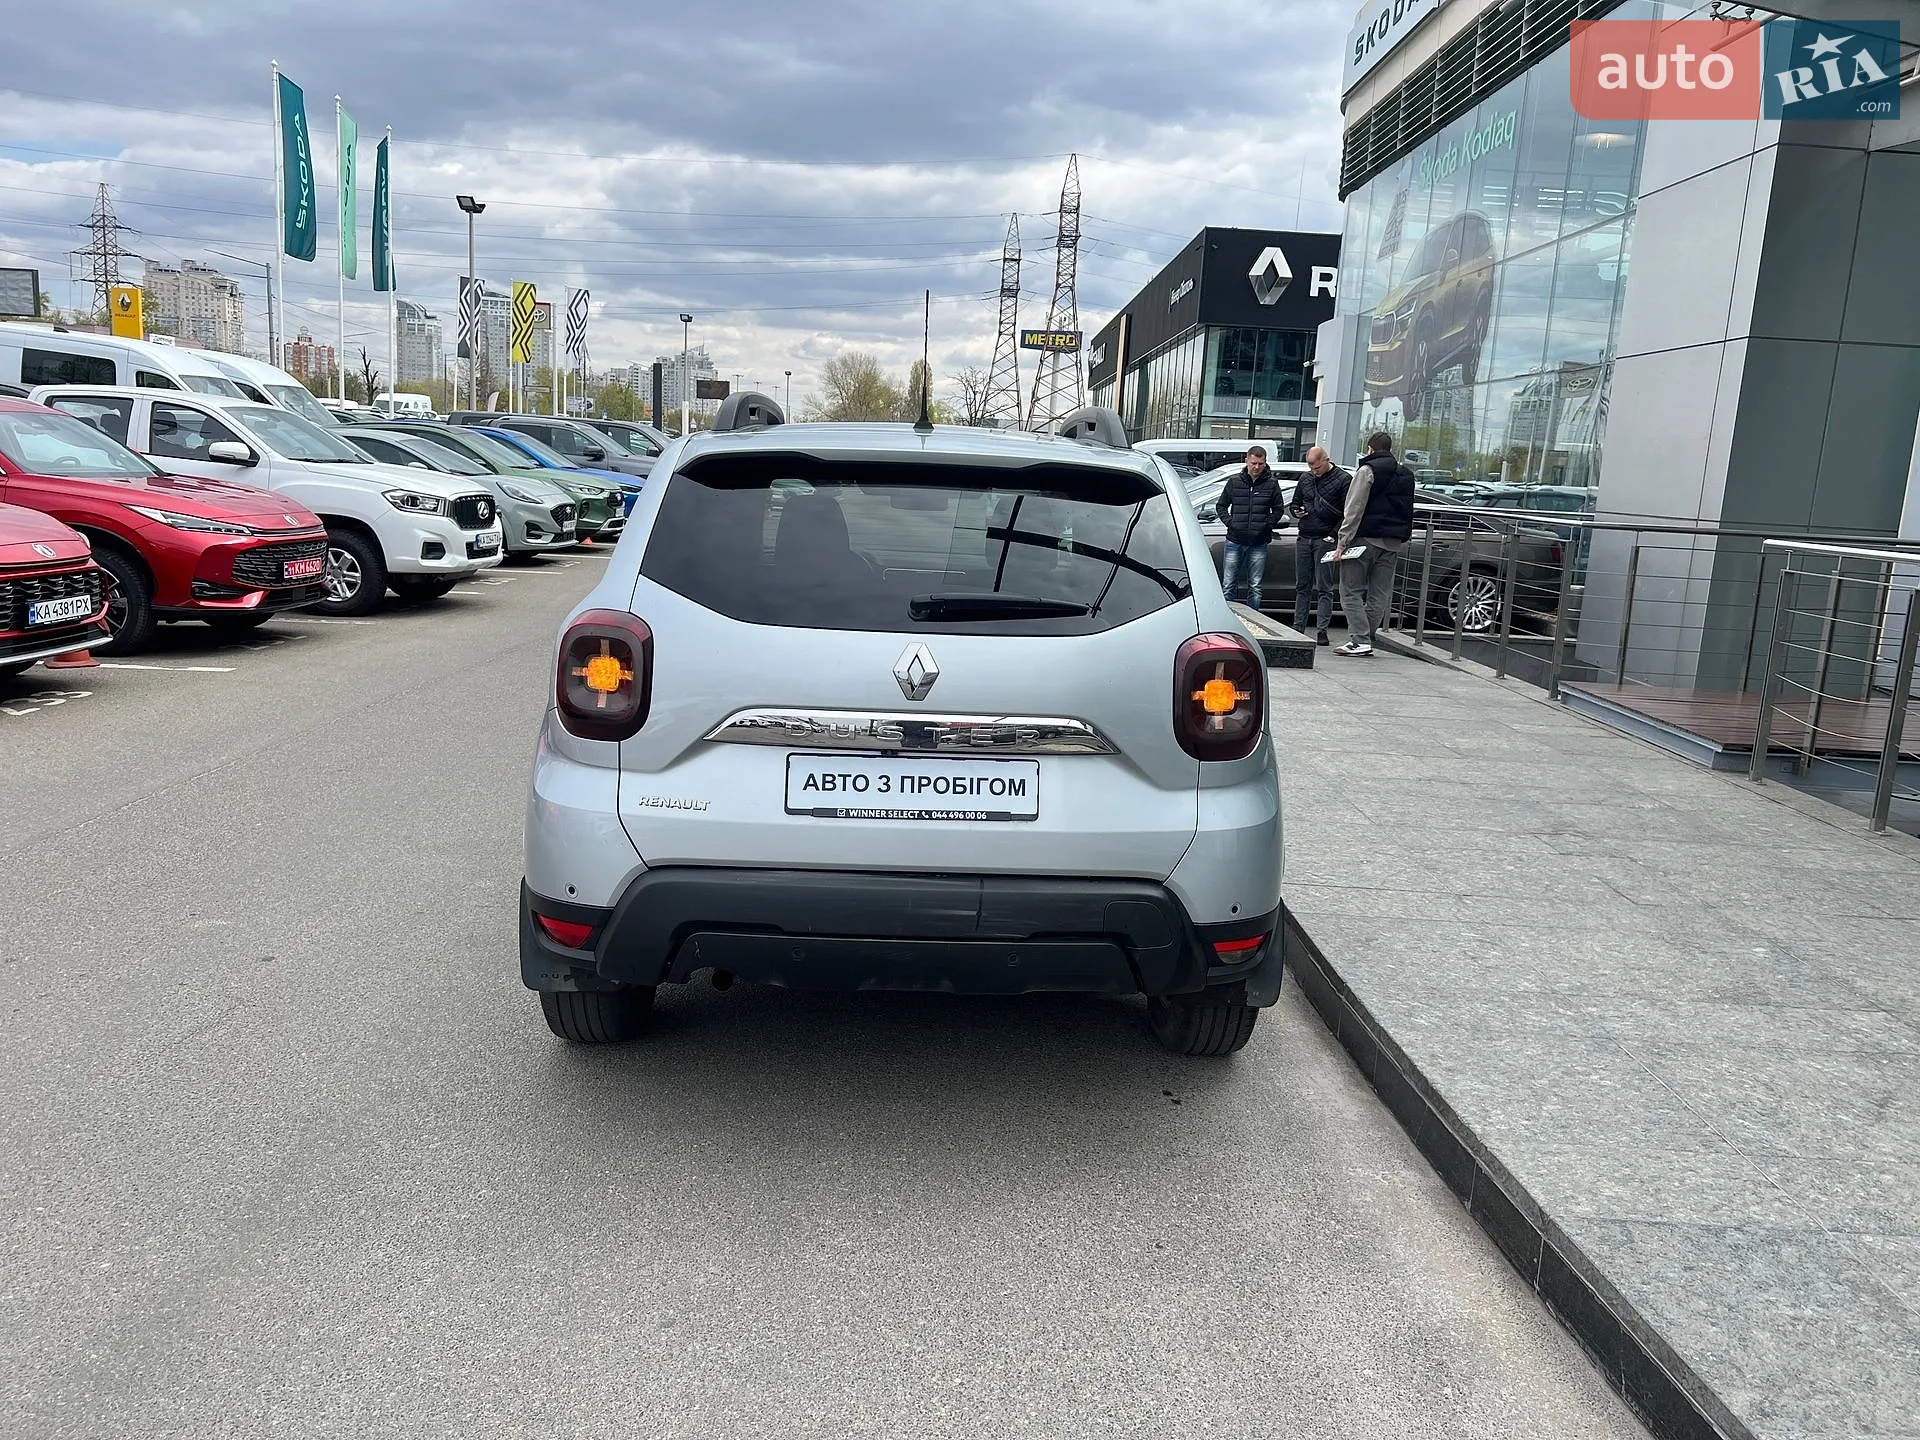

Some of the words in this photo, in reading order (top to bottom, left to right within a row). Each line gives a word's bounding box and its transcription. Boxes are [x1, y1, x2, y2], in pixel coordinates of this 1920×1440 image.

[1354, 0, 1419, 66] SKOD
[1461, 110, 1517, 167] Kodiaq
[1025, 333, 1076, 346] METRO
[36, 604, 51, 620] KA
[53, 600, 75, 616] 4381
[75, 598, 90, 613] PX
[784, 722, 1041, 746] DUSTER
[802, 773, 870, 792] АВТО
[900, 775, 1026, 796] ПРОБІГОМ
[639, 796, 711, 811] RENAULT
[848, 809, 888, 818] WINNER
[888, 810, 920, 819] SELECT
[932, 811, 947, 820] 044
[949, 811, 964, 820] 496
[965, 812, 976, 820] 00
[977, 812, 987, 820] 06
